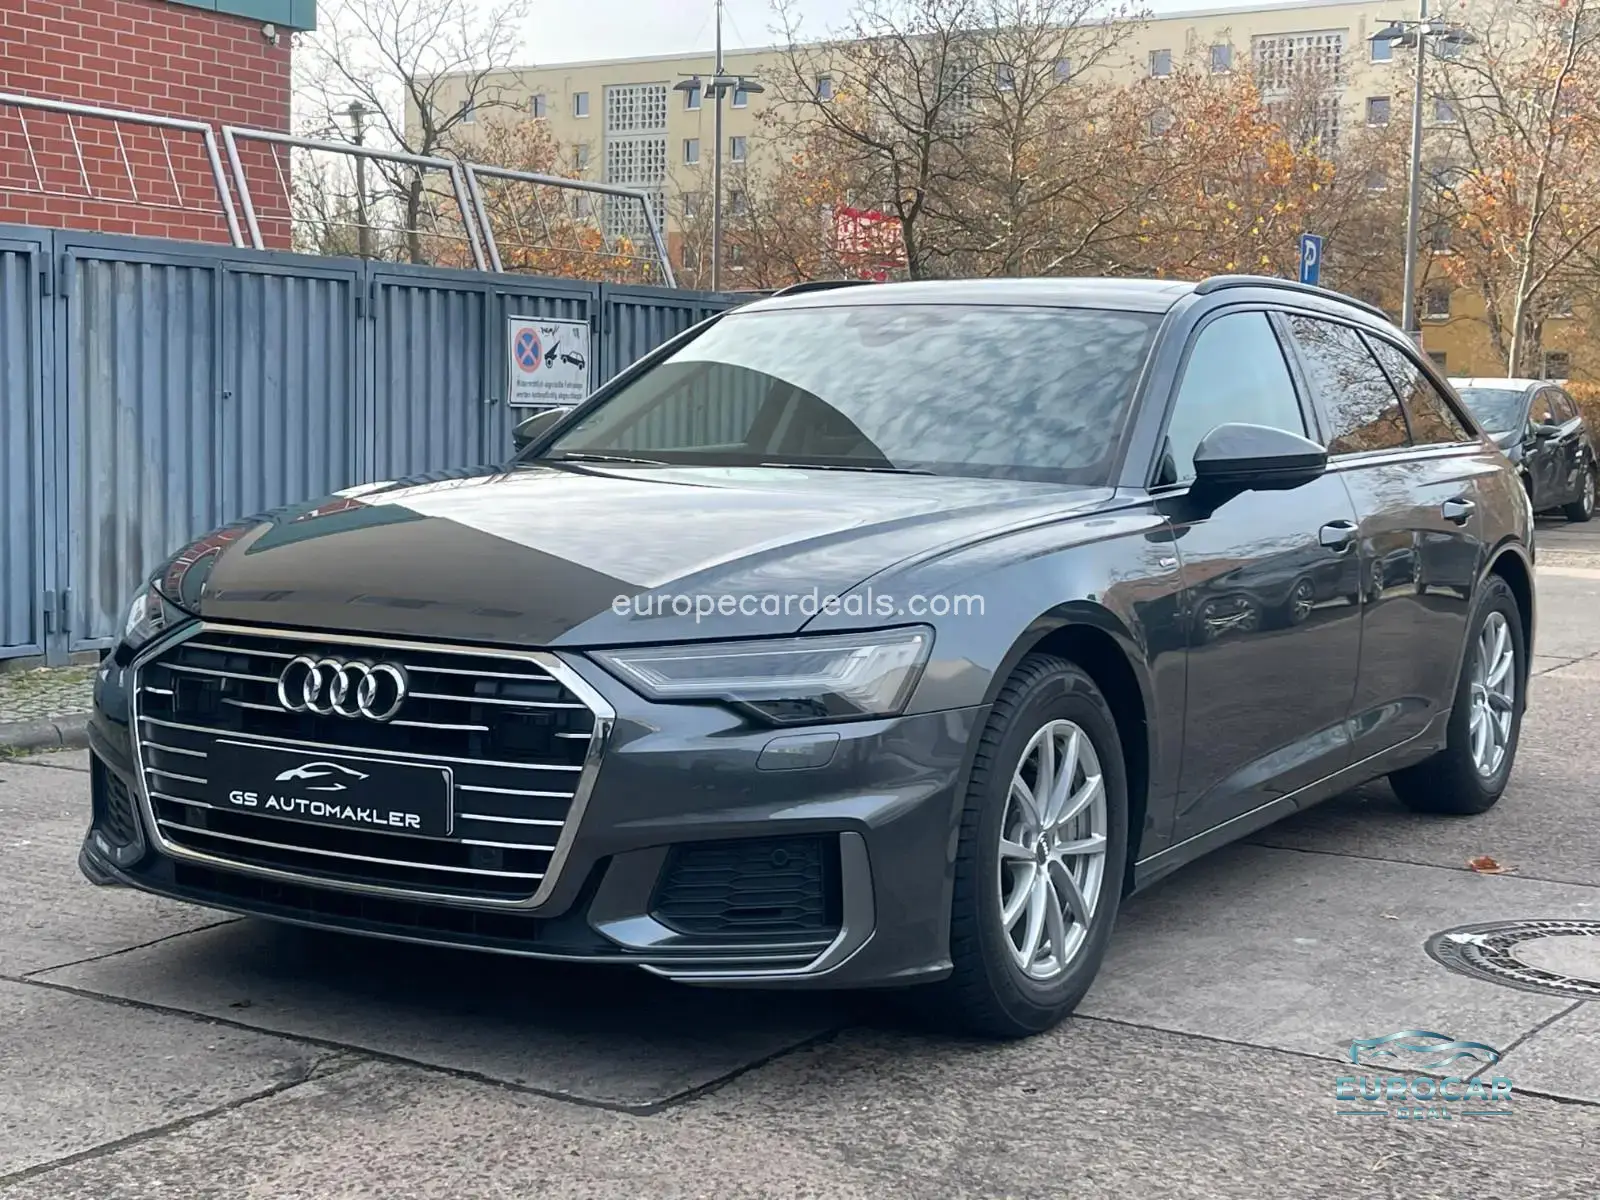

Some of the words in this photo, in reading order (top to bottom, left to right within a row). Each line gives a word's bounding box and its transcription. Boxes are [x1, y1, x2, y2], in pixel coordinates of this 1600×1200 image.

[1303, 239, 1317, 281] P
[229, 790, 258, 806] GS
[265, 795, 421, 829] AUTOMAKLER
